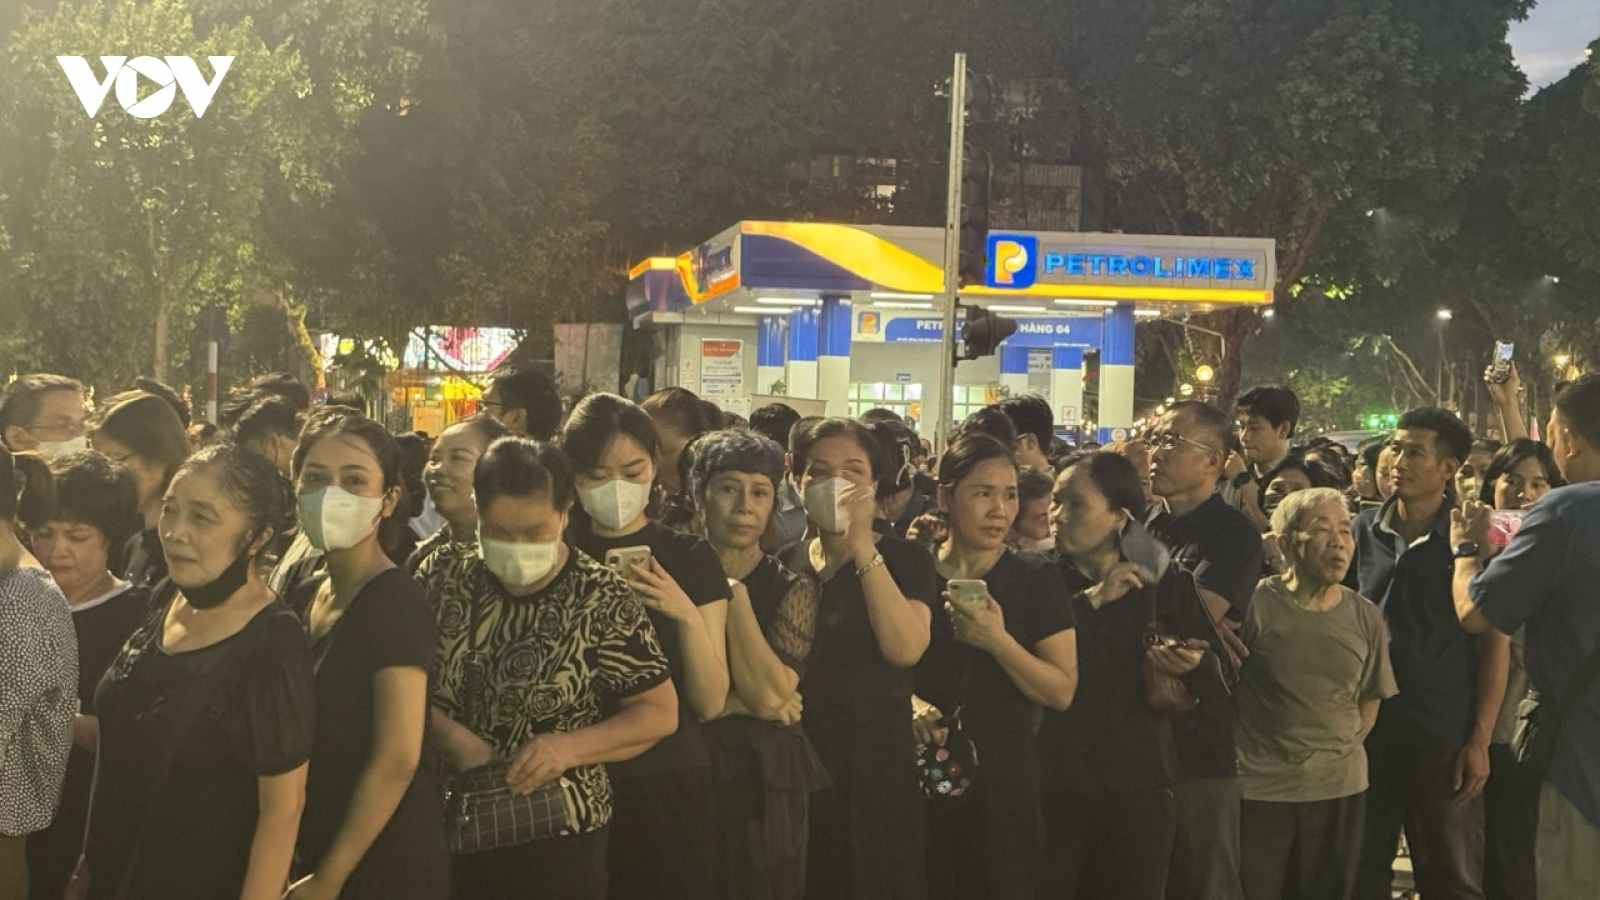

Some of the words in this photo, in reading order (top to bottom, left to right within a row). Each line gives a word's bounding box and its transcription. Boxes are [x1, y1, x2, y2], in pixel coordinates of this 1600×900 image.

[1045, 253, 1257, 280] PETROLIMEX
[1020, 321, 1054, 334] HÀNG
[1055, 324, 1071, 334] 04
